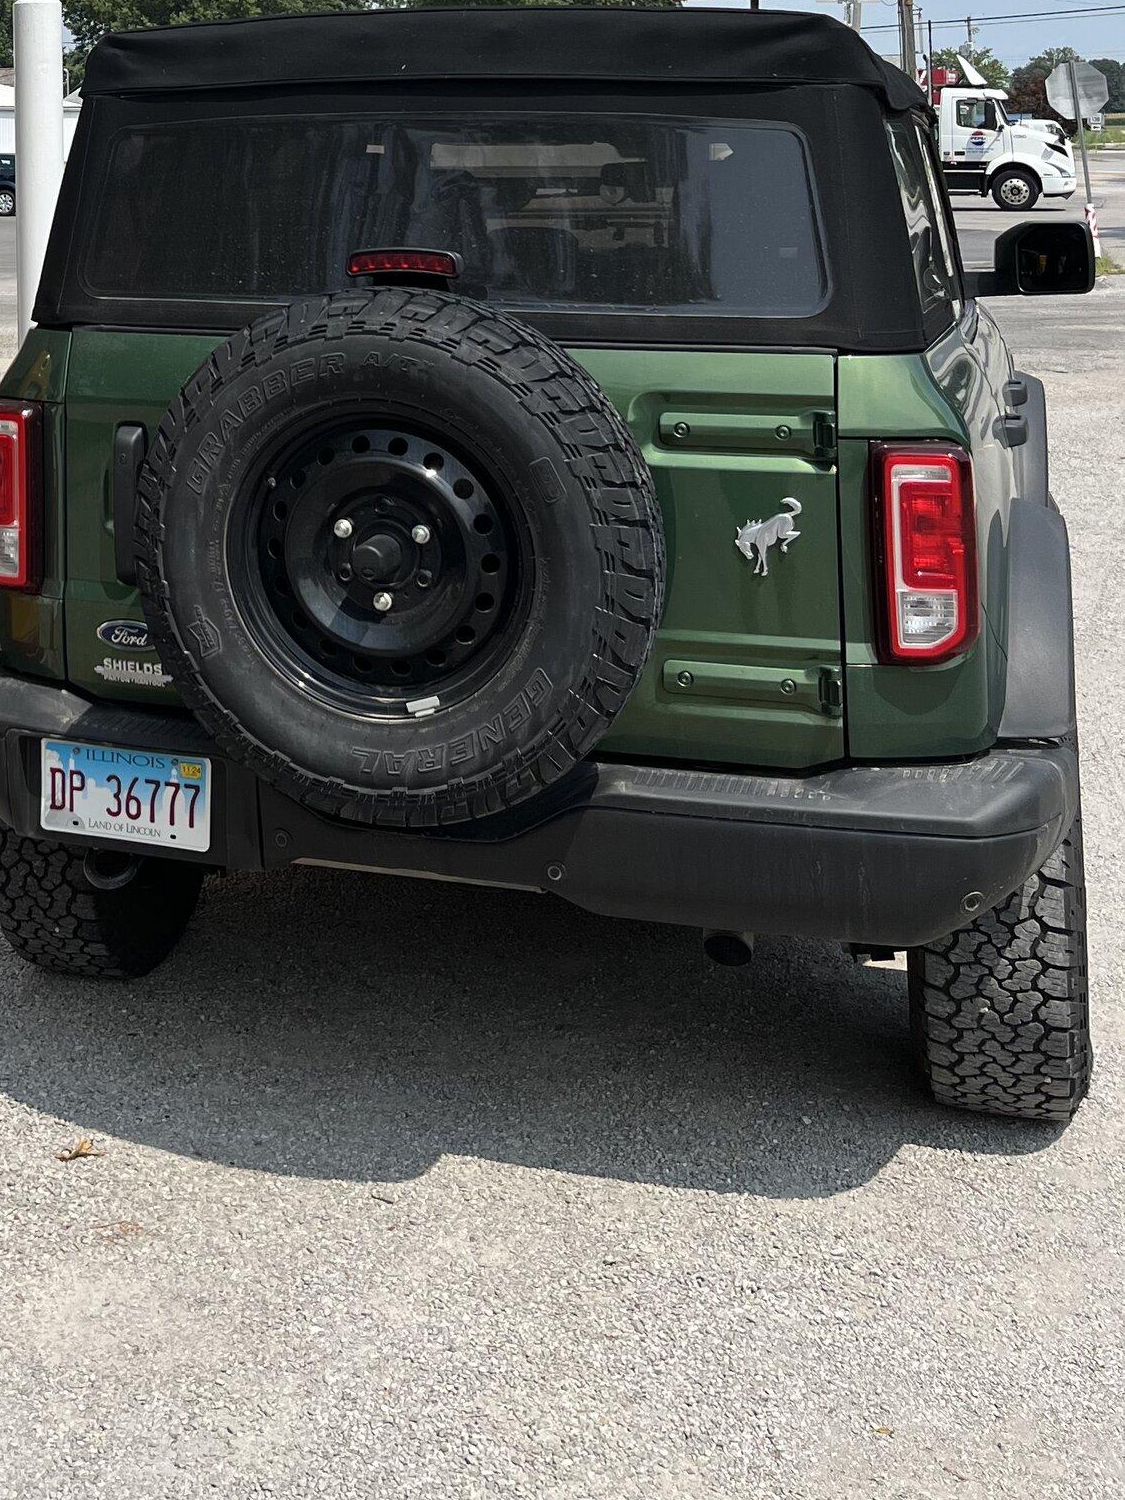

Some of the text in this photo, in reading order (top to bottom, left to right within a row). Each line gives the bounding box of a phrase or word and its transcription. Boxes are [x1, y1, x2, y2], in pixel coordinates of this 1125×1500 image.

[185, 350, 346, 497] GRABBER
[111, 626, 148, 646] Ford
[103, 657, 163, 676] SHIELDS
[351, 666, 554, 774] GENERAL
[85, 749, 166, 769] ILLINOIS
[49, 767, 200, 829] DP 36777
[88, 817, 162, 838] LAND OF LINCOLN
